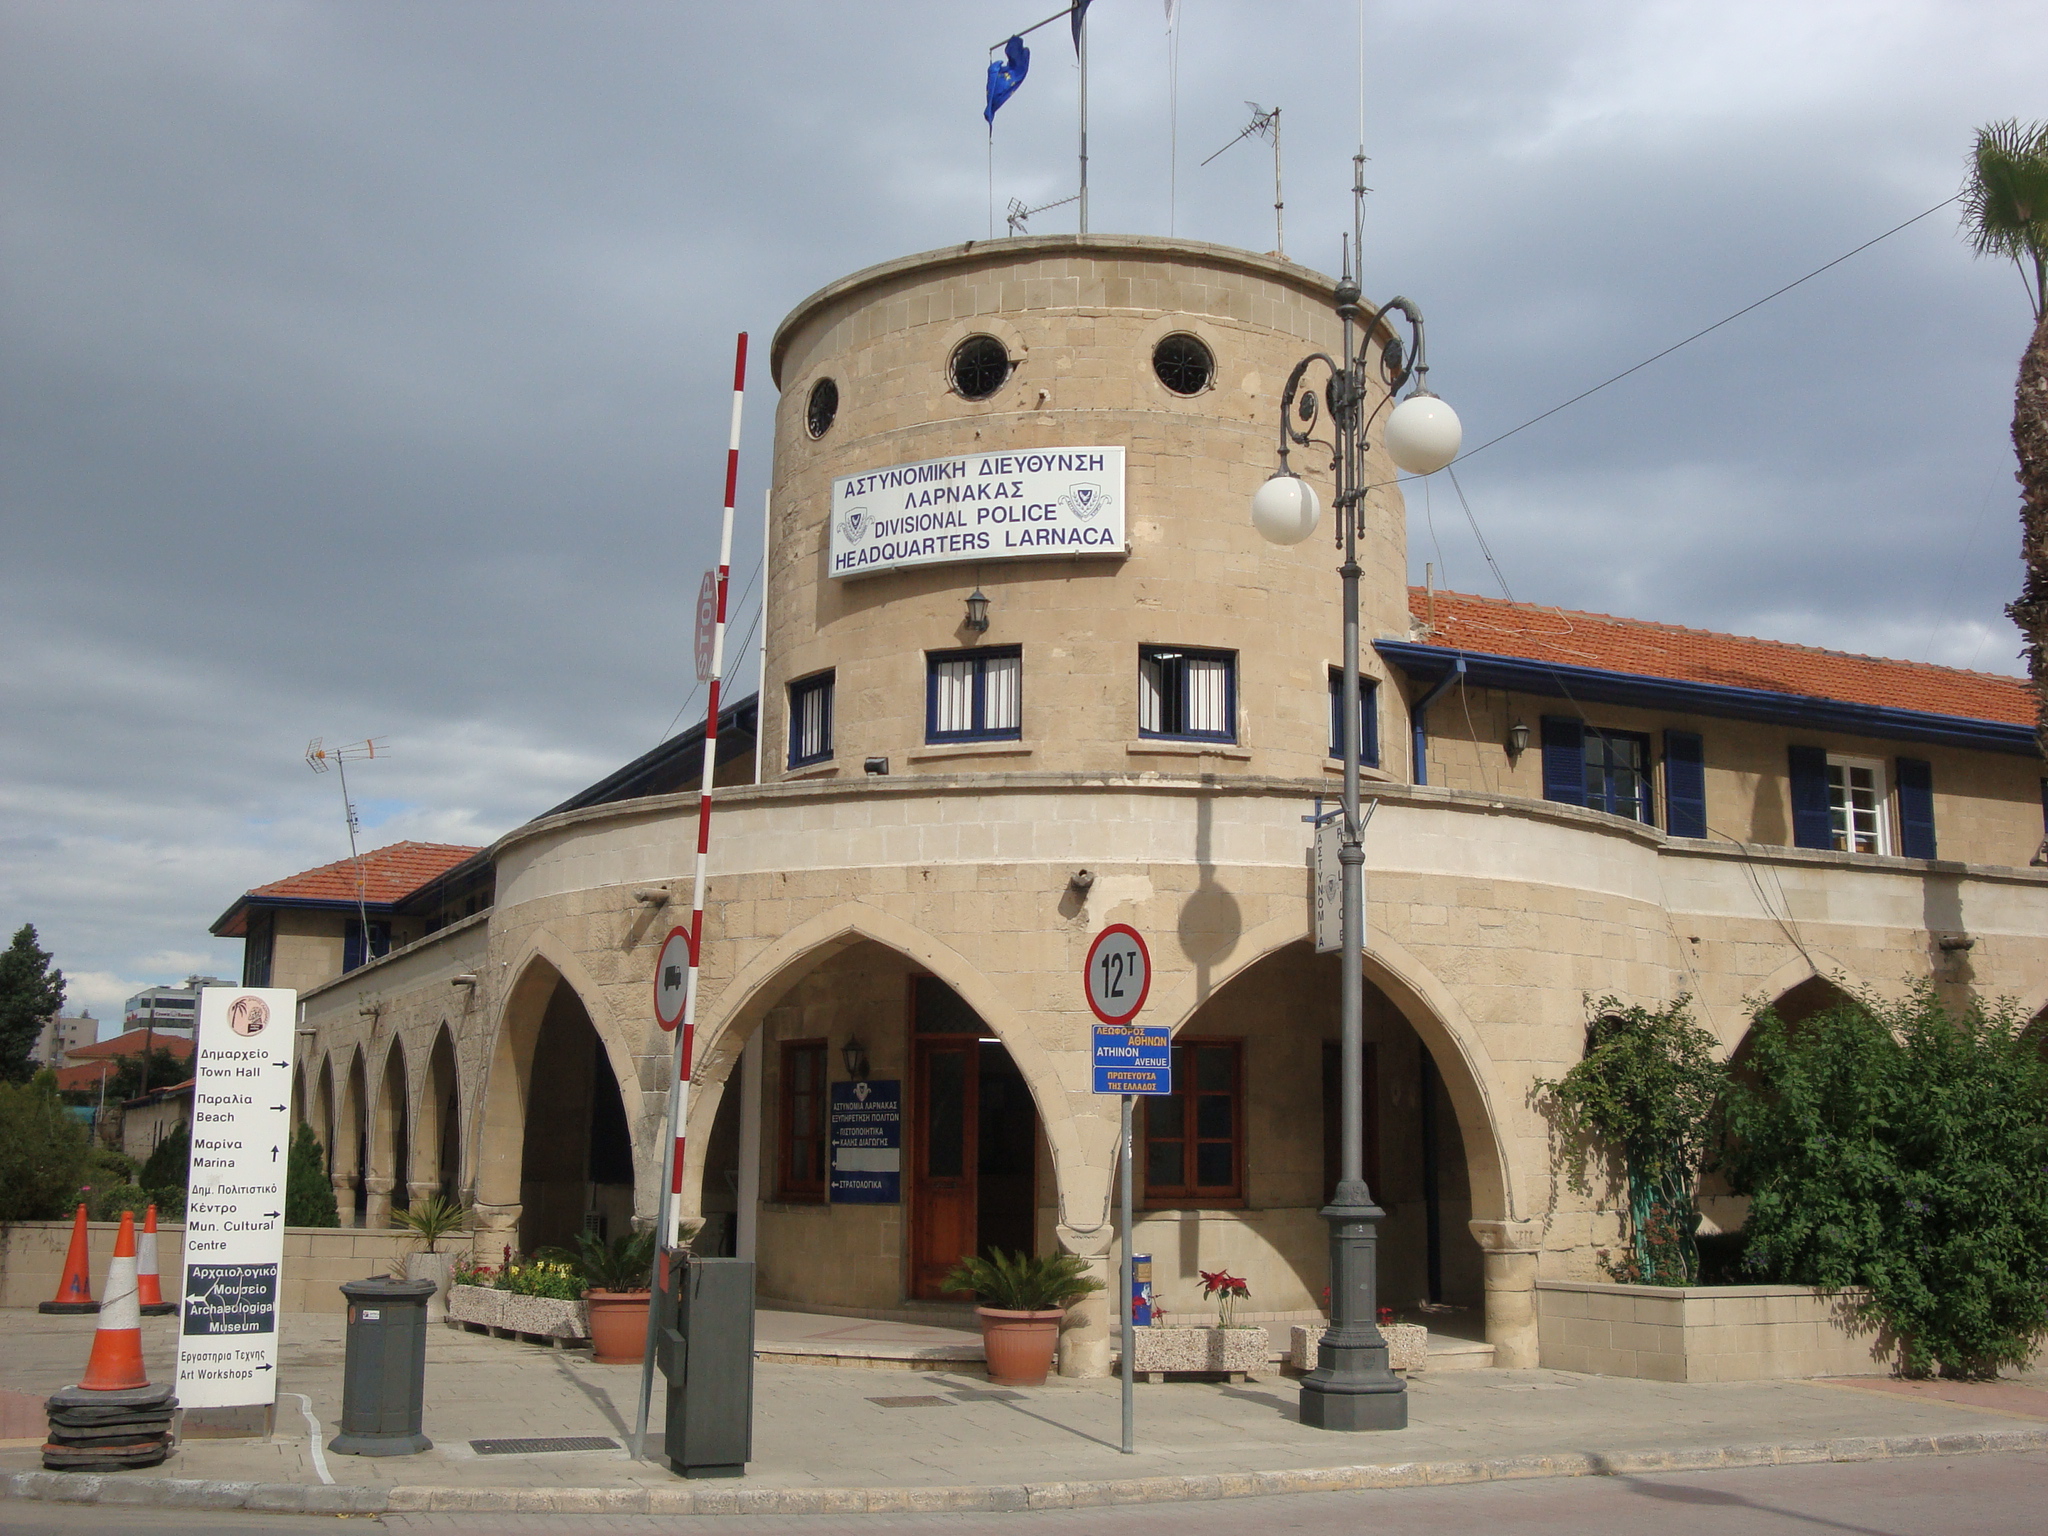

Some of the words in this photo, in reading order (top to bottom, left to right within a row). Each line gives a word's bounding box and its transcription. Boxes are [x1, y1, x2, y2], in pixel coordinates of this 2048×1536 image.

[845, 461, 965, 499] ΑΣΤΥΝΟΜΙΚΗ
[979, 455, 1104, 475] ΔΙΕΥΘΥΝΣΗ
[905, 481, 1023, 510] ΛΑΡΝΑΚΑΣ
[875, 510, 967, 538] DIVISIONAL
[977, 504, 1057, 525] POLICE
[836, 532, 990, 570] HEADQUARTERS
[1005, 527, 1114, 547] LARNACA
[698, 576, 712, 675] STOP
[1128, 1036, 1167, 1046] ΑΘΗΝΩΝ
[201, 1049, 268, 1061] Δημαρχείο
[1097, 1047, 1139, 1057] ATHINON
[1135, 1058, 1167, 1066] AVENUE
[201, 1067, 231, 1077] Town
[236, 1068, 260, 1077] Hall
[1107, 1072, 1156, 1080] ΠΡΩΤΕΥΟΥΣΑ
[198, 1094, 252, 1106] Παραλία
[833, 1102, 863, 1110] ΑΣΤΥΝΟΜΙΑ
[197, 1112, 234, 1122] Beach
[195, 1139, 242, 1151] Μαρίνα
[194, 1158, 235, 1167] Marina
[192, 1185, 214, 1196] Δημ.
[218, 1183, 277, 1194] Πολιτιστικό
[191, 1203, 237, 1215] Κέντρο
[189, 1222, 219, 1231] Mun.
[224, 1221, 273, 1231] Cultural
[189, 1240, 227, 1250] Centre
[193, 1266, 276, 1279] Αρχαιολογικό
[214, 1284, 267, 1294] Μουσείο
[210, 1322, 259, 1332] Museum
[181, 1351, 231, 1363] Εργαστηρια
[235, 1350, 265, 1361] Τεχνης
[181, 1370, 194, 1379] Art
[198, 1369, 253, 1380] Workshops
